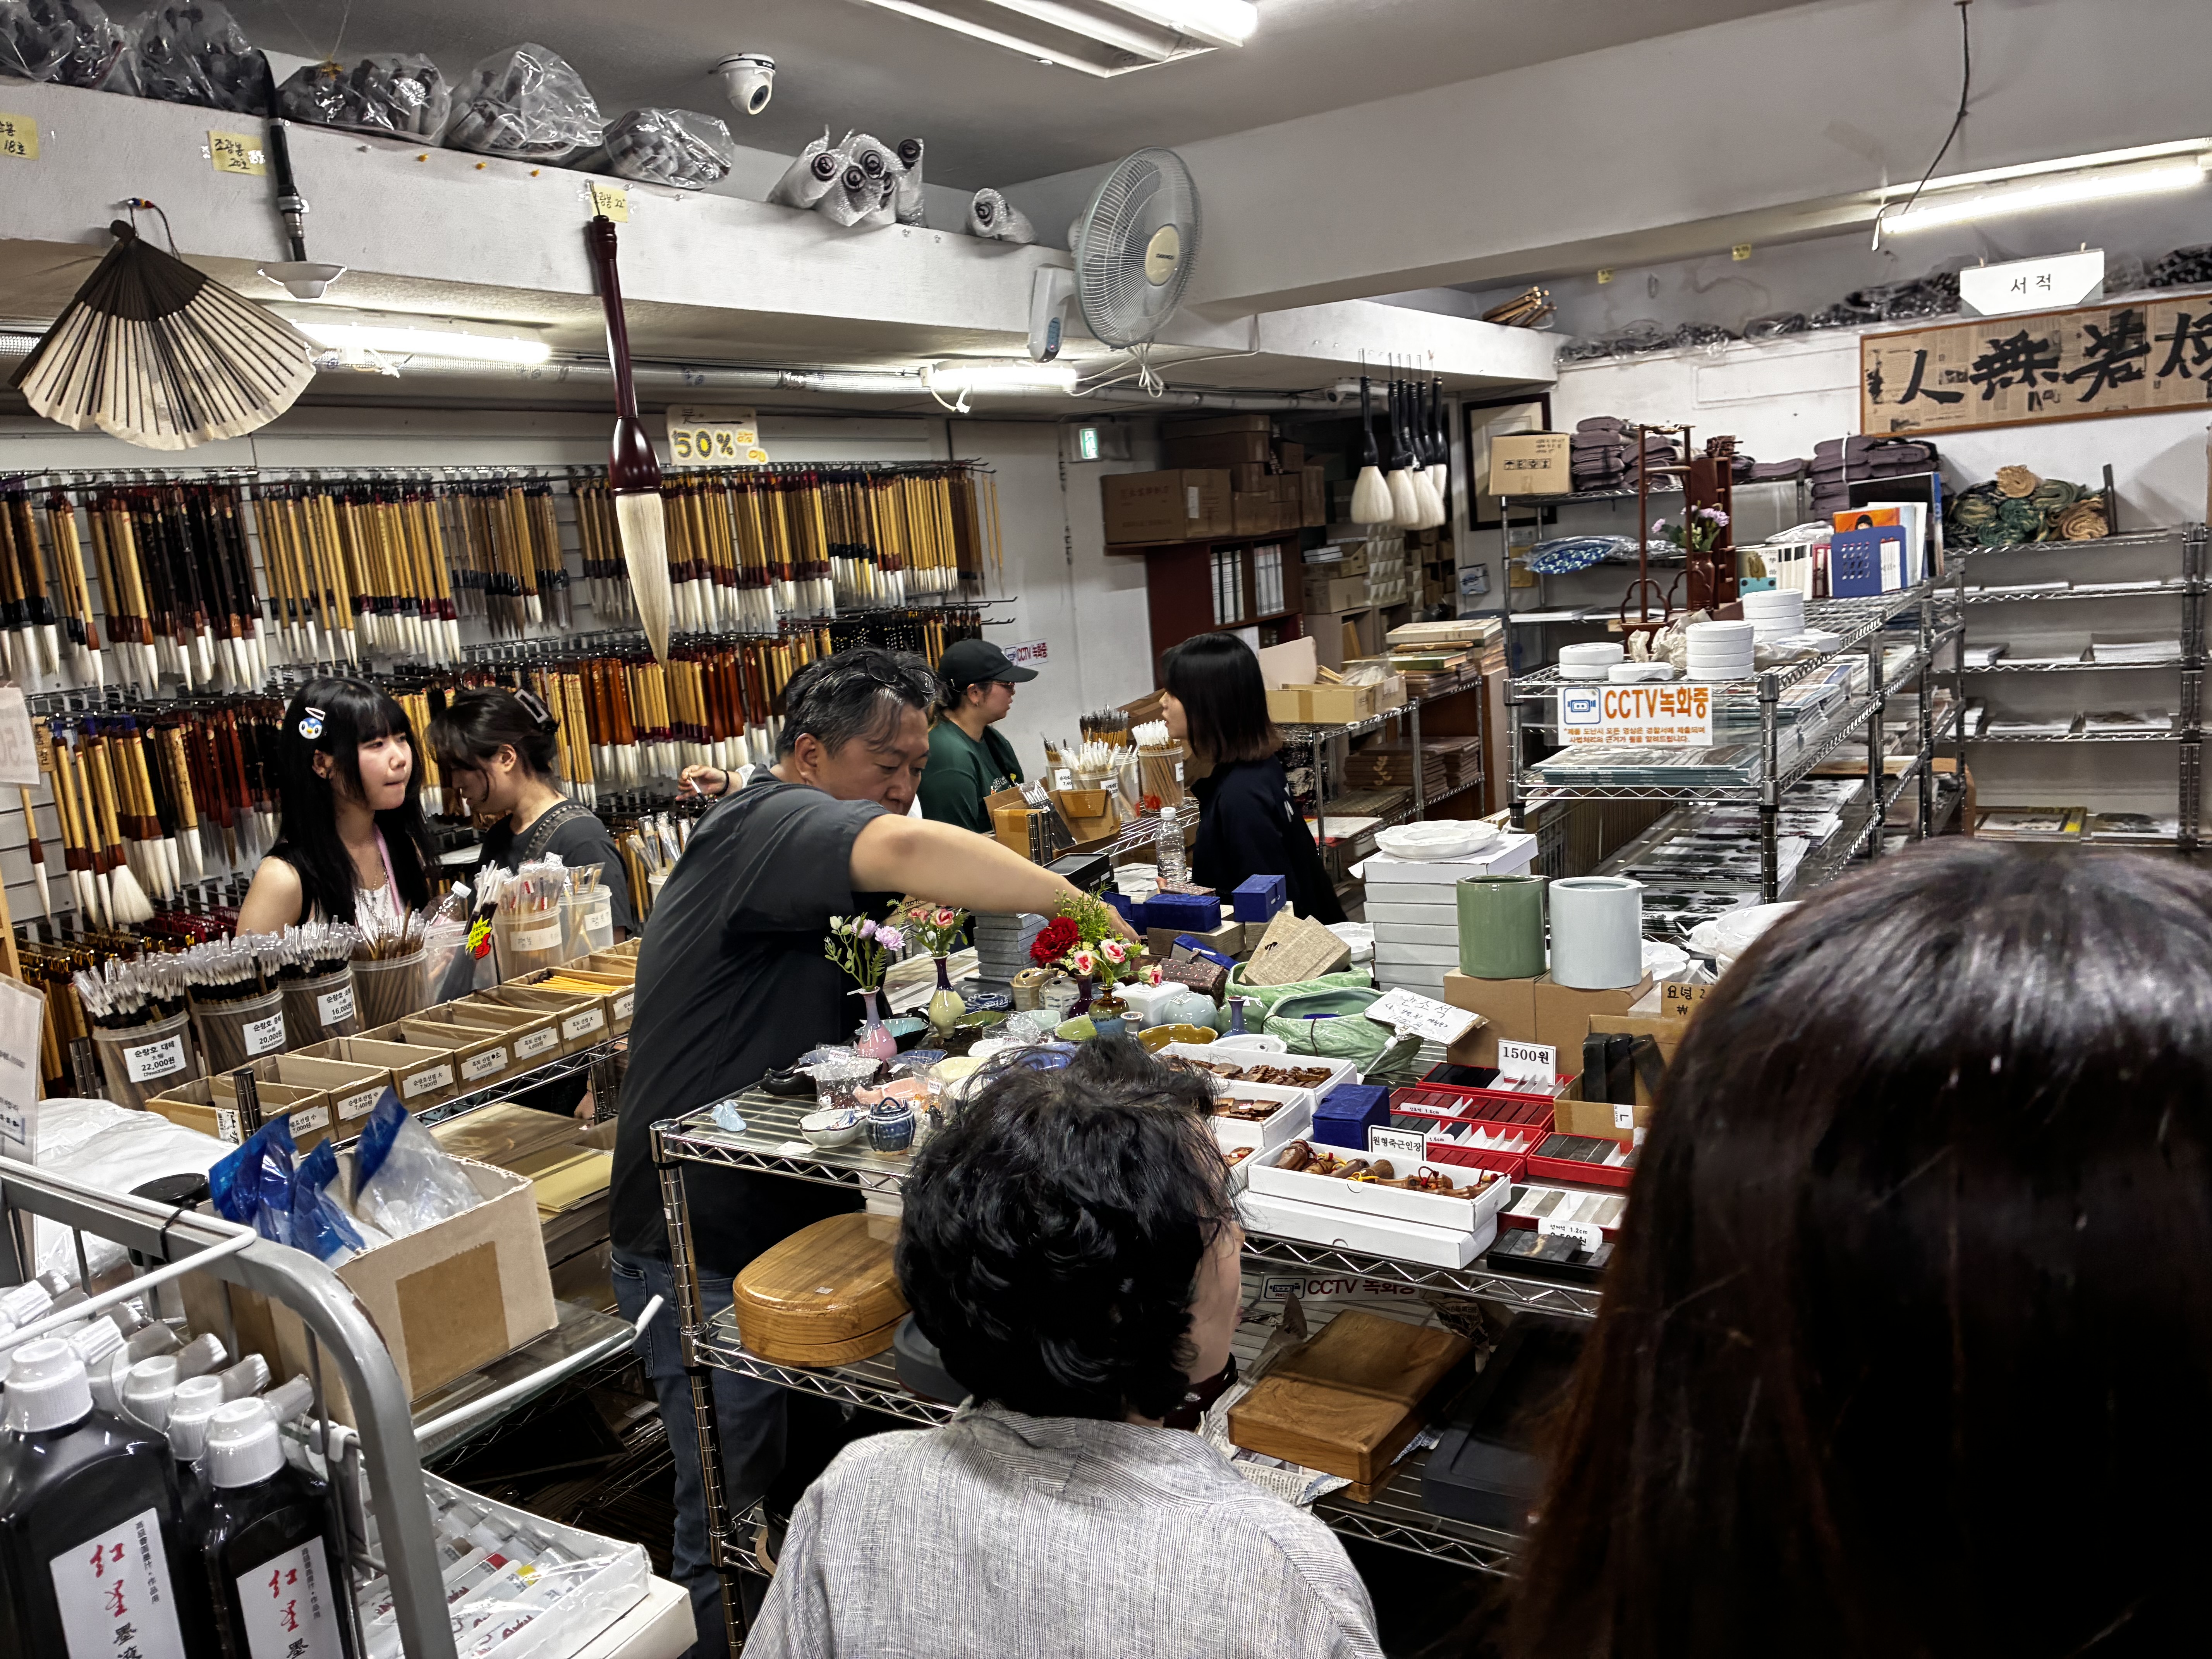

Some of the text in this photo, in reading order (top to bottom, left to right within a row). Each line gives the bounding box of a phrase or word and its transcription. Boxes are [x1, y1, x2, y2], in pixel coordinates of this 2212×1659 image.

[2010, 273, 2052, 294] 서적
[672, 430, 735, 458] 50%
[1667, 985, 1692, 1000] 요녕
[1503, 1046, 1550, 1065] 1500원
[1372, 1136, 1422, 1152] 원형죽근인장
[1307, 1279, 1357, 1295] CCTV
